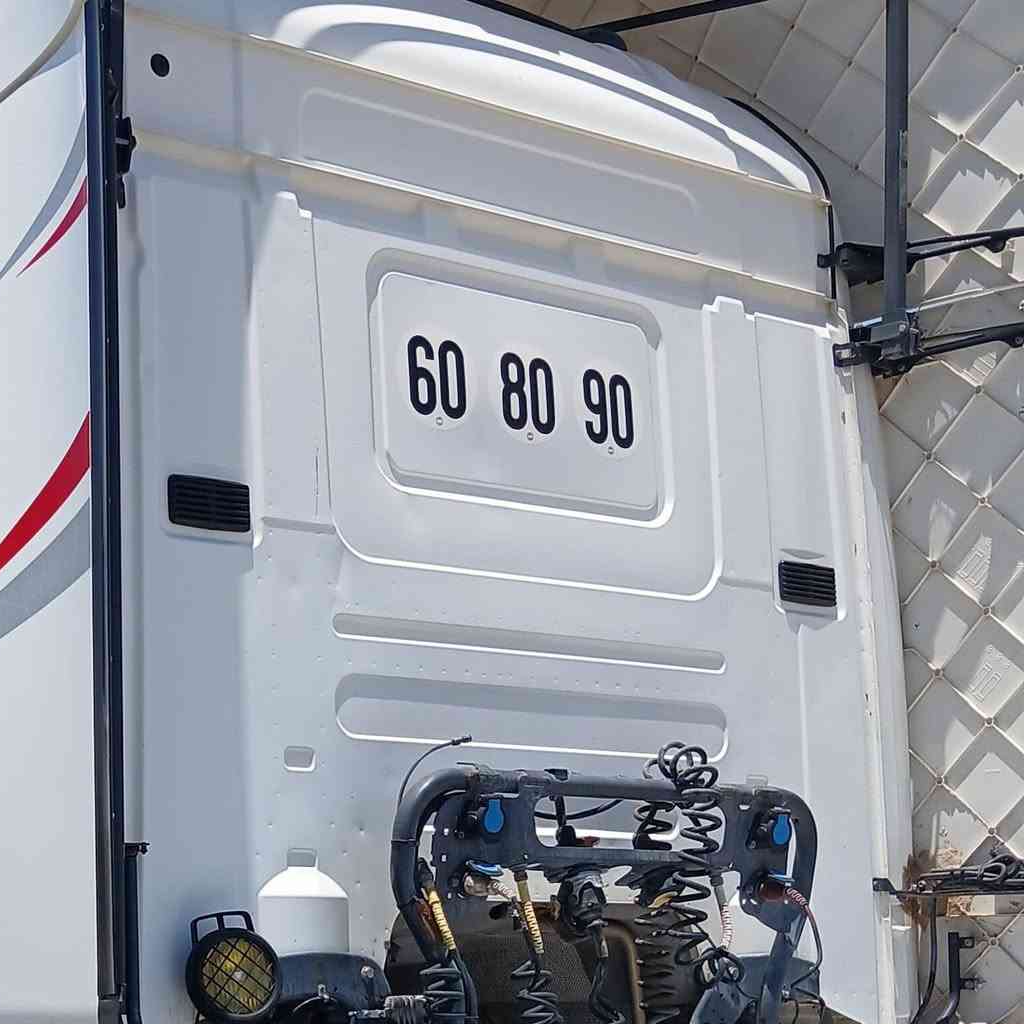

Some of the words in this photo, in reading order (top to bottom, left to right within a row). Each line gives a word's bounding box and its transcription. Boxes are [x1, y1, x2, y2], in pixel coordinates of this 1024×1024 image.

[407, 334, 467, 420] 60
[499, 351, 556, 435] 80
[582, 368, 635, 449] 90
